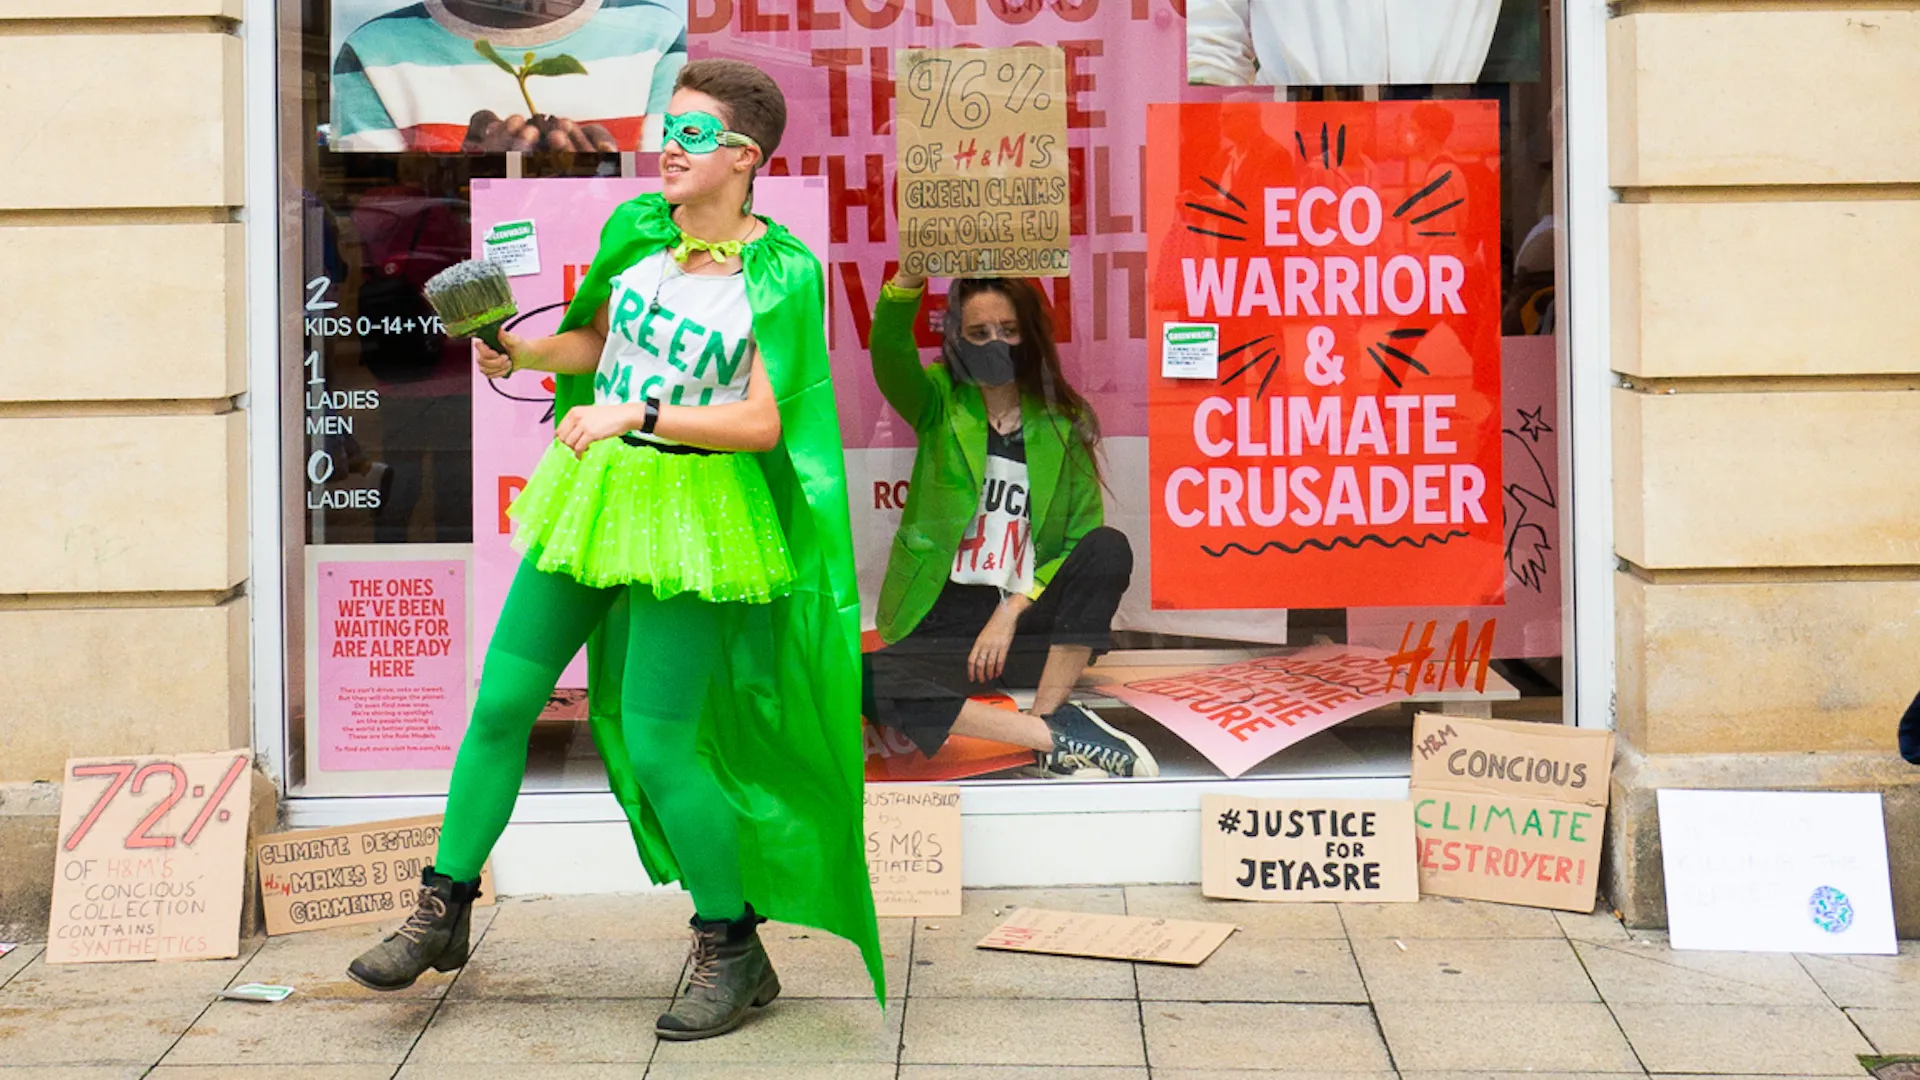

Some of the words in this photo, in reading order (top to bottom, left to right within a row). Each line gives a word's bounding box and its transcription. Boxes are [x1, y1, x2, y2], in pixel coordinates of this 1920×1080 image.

[908, 58, 1051, 130] 96%
[906, 142, 943, 173] OF
[905, 180, 980, 209] GREEN
[985, 176, 1066, 206] CLAIMS
[908, 210, 1014, 248] IGNORE
[1021, 210, 1058, 241] EU
[1263, 185, 1383, 247] ECO
[905, 247, 1070, 275] COMMISSION
[305, 276, 339, 311] 2
[1181, 254, 1468, 317] WARRIOR
[304, 317, 352, 336] KIDS
[356, 316, 416, 335] 0-14+
[611, 277, 748, 387] REEN
[304, 350, 326, 385] 1
[1303, 325, 1346, 387] &
[305, 391, 380, 410] LADIES
[306, 416, 353, 435] MEN
[1192, 394, 1458, 458] CLIMATE
[307, 449, 334, 485] 0
[307, 490, 381, 509] LADIES
[980, 478, 1031, 518] UC
[1163, 463, 1489, 528] CRUSADER
[350, 579, 383, 597] THE
[386, 578, 434, 597] ONES
[338, 599, 396, 617] WE'VE
[399, 598, 445, 616] BEEN
[334, 619, 411, 637] WAITING
[414, 618, 449, 636] FOR
[332, 640, 367, 657] ARE
[370, 638, 452, 657] ALREADY
[1384, 617, 1496, 696] H&M
[369, 659, 415, 677] HERE
[1238, 687, 1327, 728] THE
[1416, 724, 1458, 760] H&M
[1447, 748, 1588, 789] CONCIOUS
[64, 755, 249, 851] 72%
[1217, 808, 1376, 838] #JUSTICE
[1414, 799, 1592, 843] CLIMATE
[259, 836, 350, 865] CLIMATE
[1325, 842, 1365, 859] FOR
[64, 860, 98, 881] OF
[107, 857, 174, 879] H&M'S
[290, 864, 367, 894] MAKES
[372, 862, 388, 884] 3
[1235, 858, 1381, 891] JEYASRE
[69, 899, 206, 920] COLLECTION
[290, 891, 394, 924] GARMENTS
[56, 923, 155, 939] CONTAINS
[68, 936, 208, 957] SYNTHETICS
